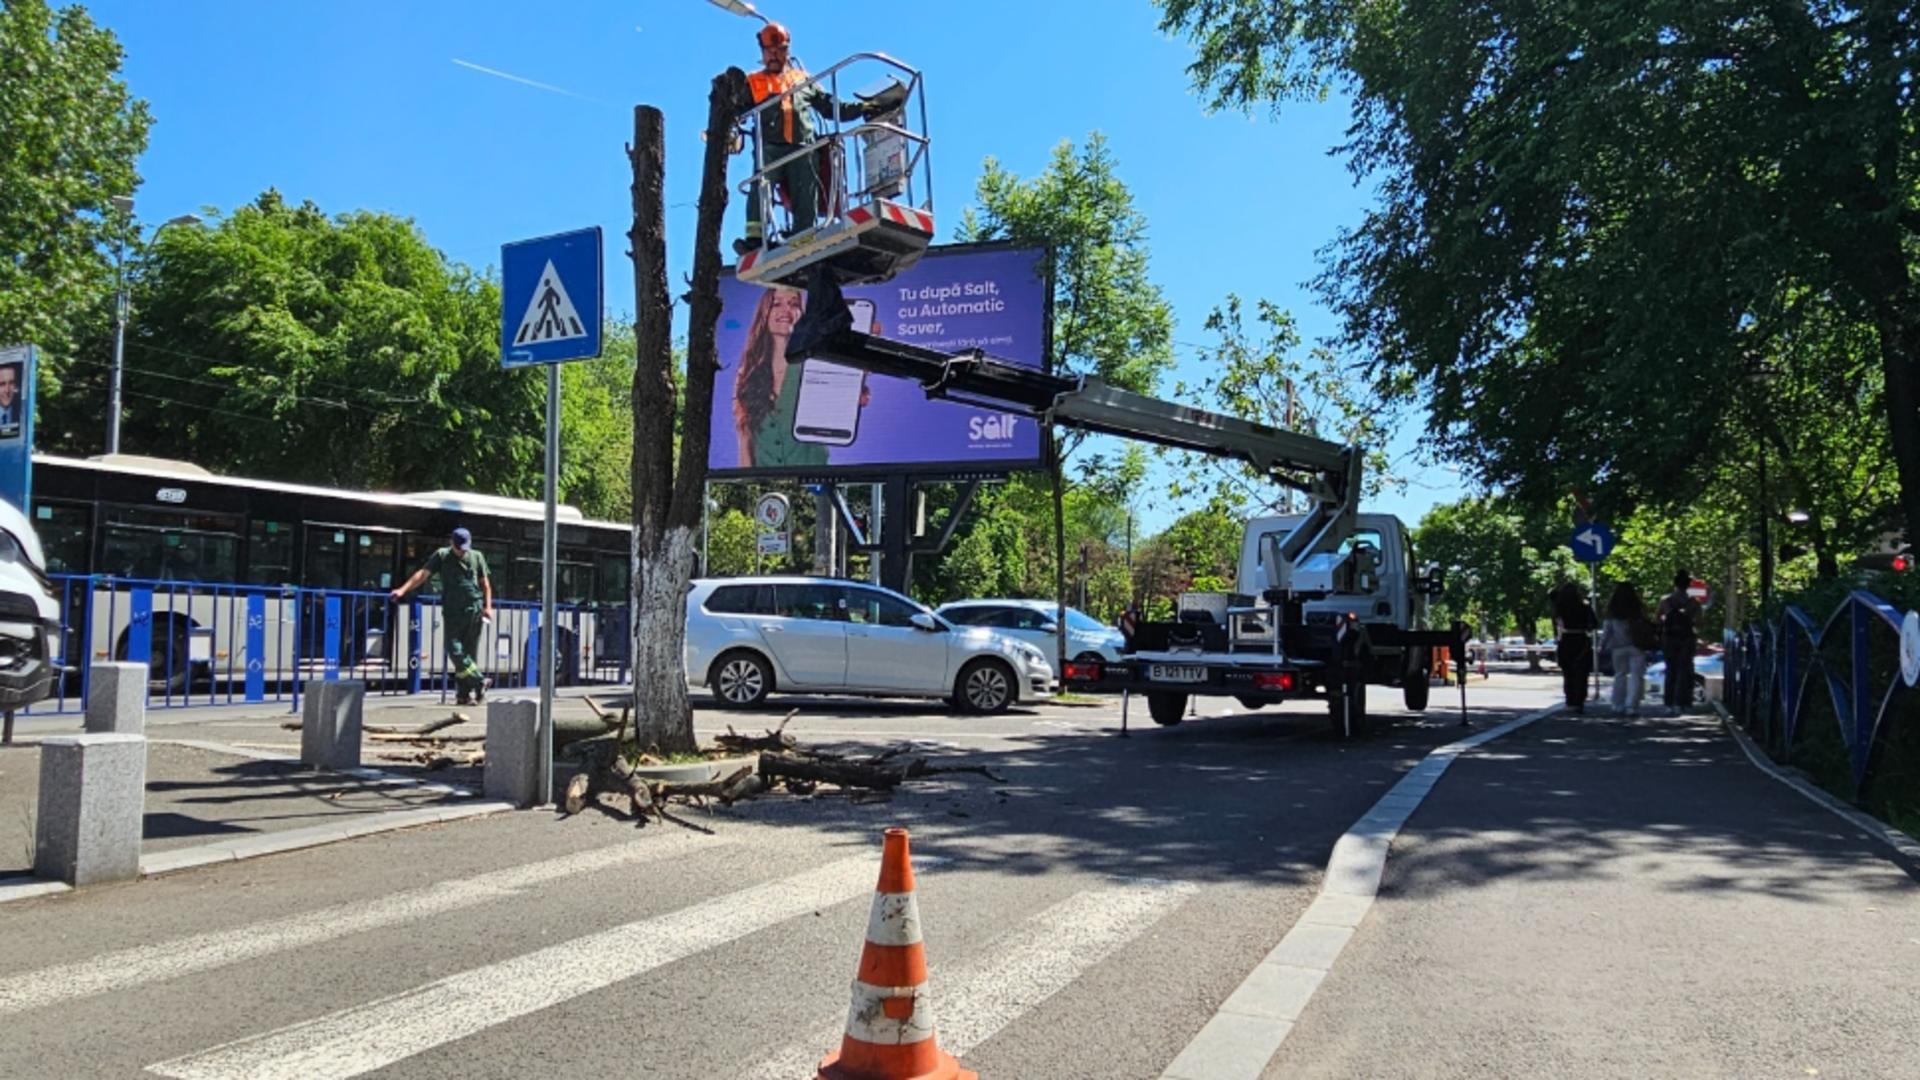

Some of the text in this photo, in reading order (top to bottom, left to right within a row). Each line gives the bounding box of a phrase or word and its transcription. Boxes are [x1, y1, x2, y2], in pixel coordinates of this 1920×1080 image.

[899, 280, 1000, 302] Tu după Salt,
[898, 298, 1005, 319] cu Automatic
[897, 322, 945, 336] Saver,
